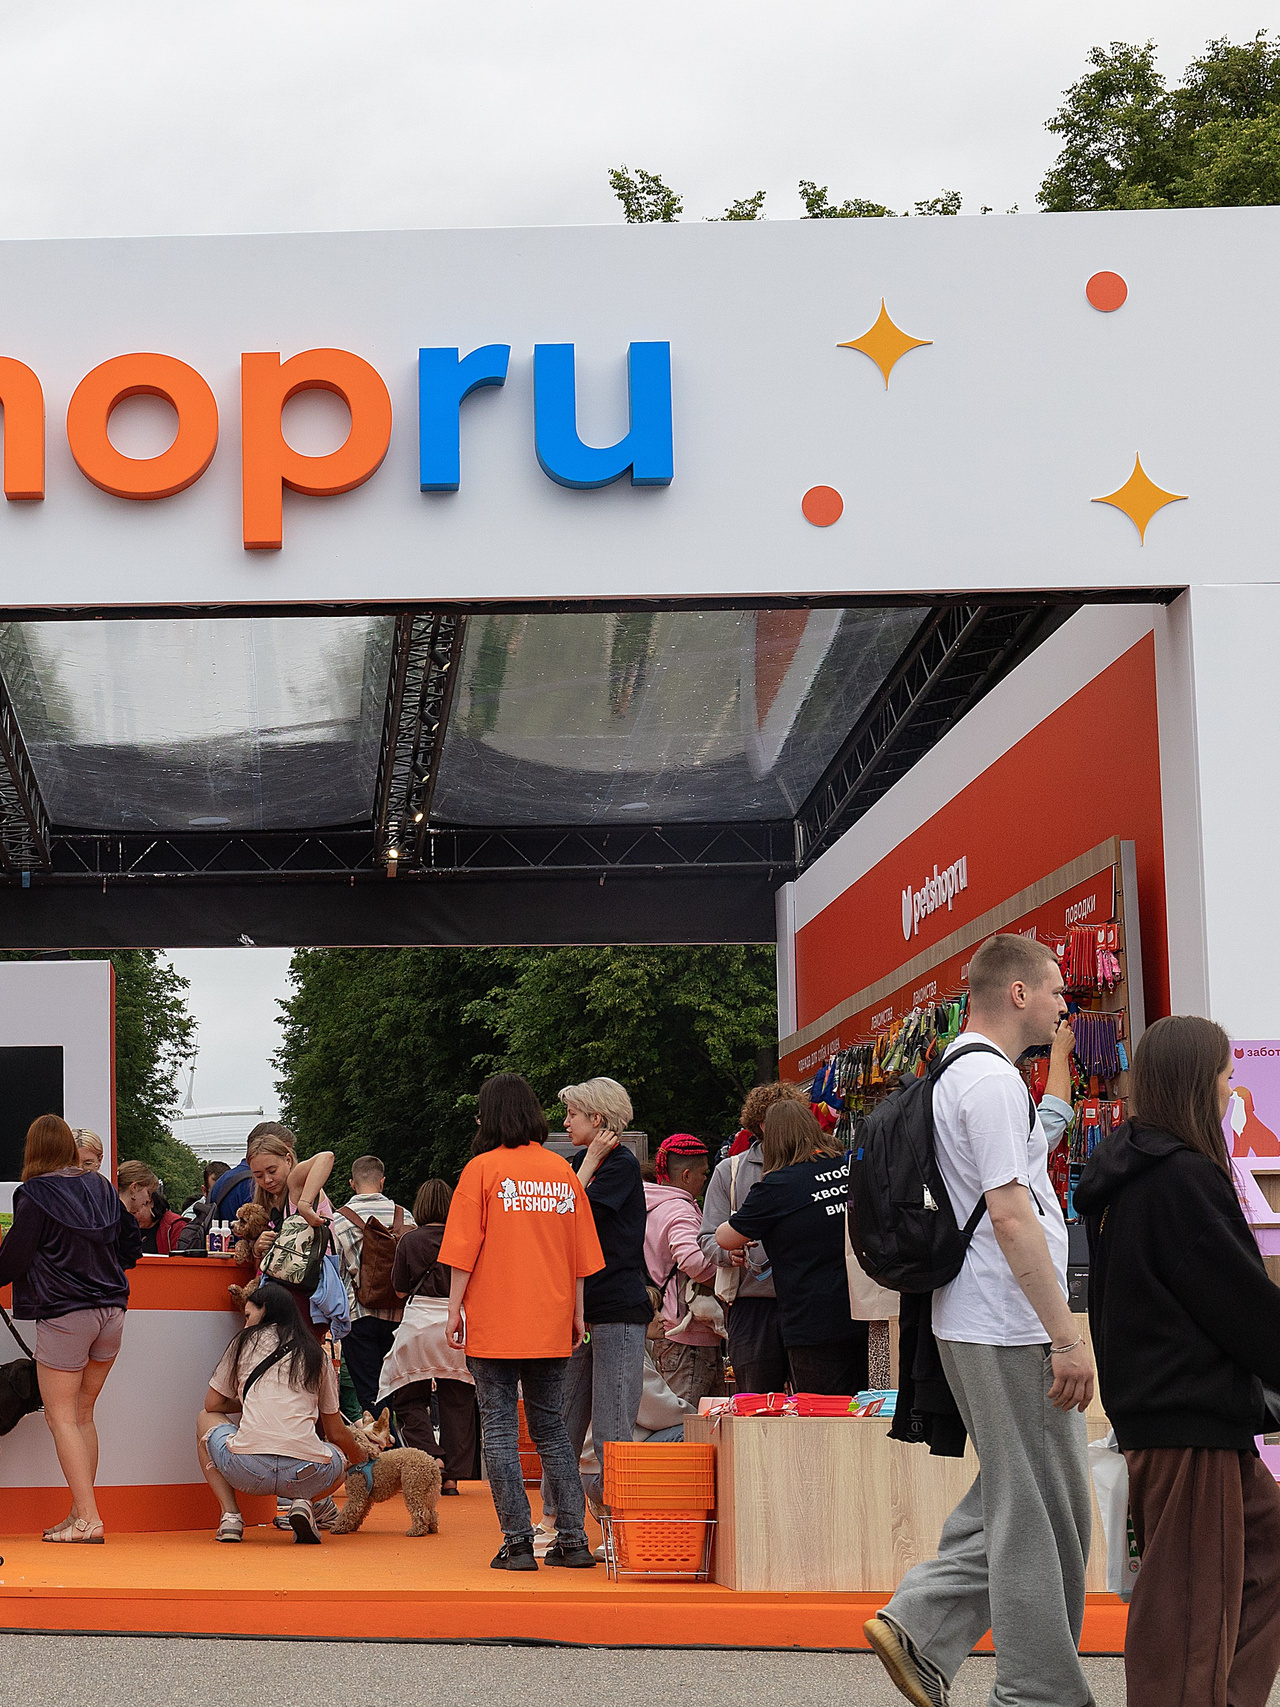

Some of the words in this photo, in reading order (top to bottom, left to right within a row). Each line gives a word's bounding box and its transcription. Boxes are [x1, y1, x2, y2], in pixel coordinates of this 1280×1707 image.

[913, 855, 968, 935] petshopru
[1065, 893, 1097, 925] поводки
[814, 1164, 850, 1183] чтоб
[811, 1183, 849, 1202] хвос
[503, 1196, 557, 1212] PETSHOP
